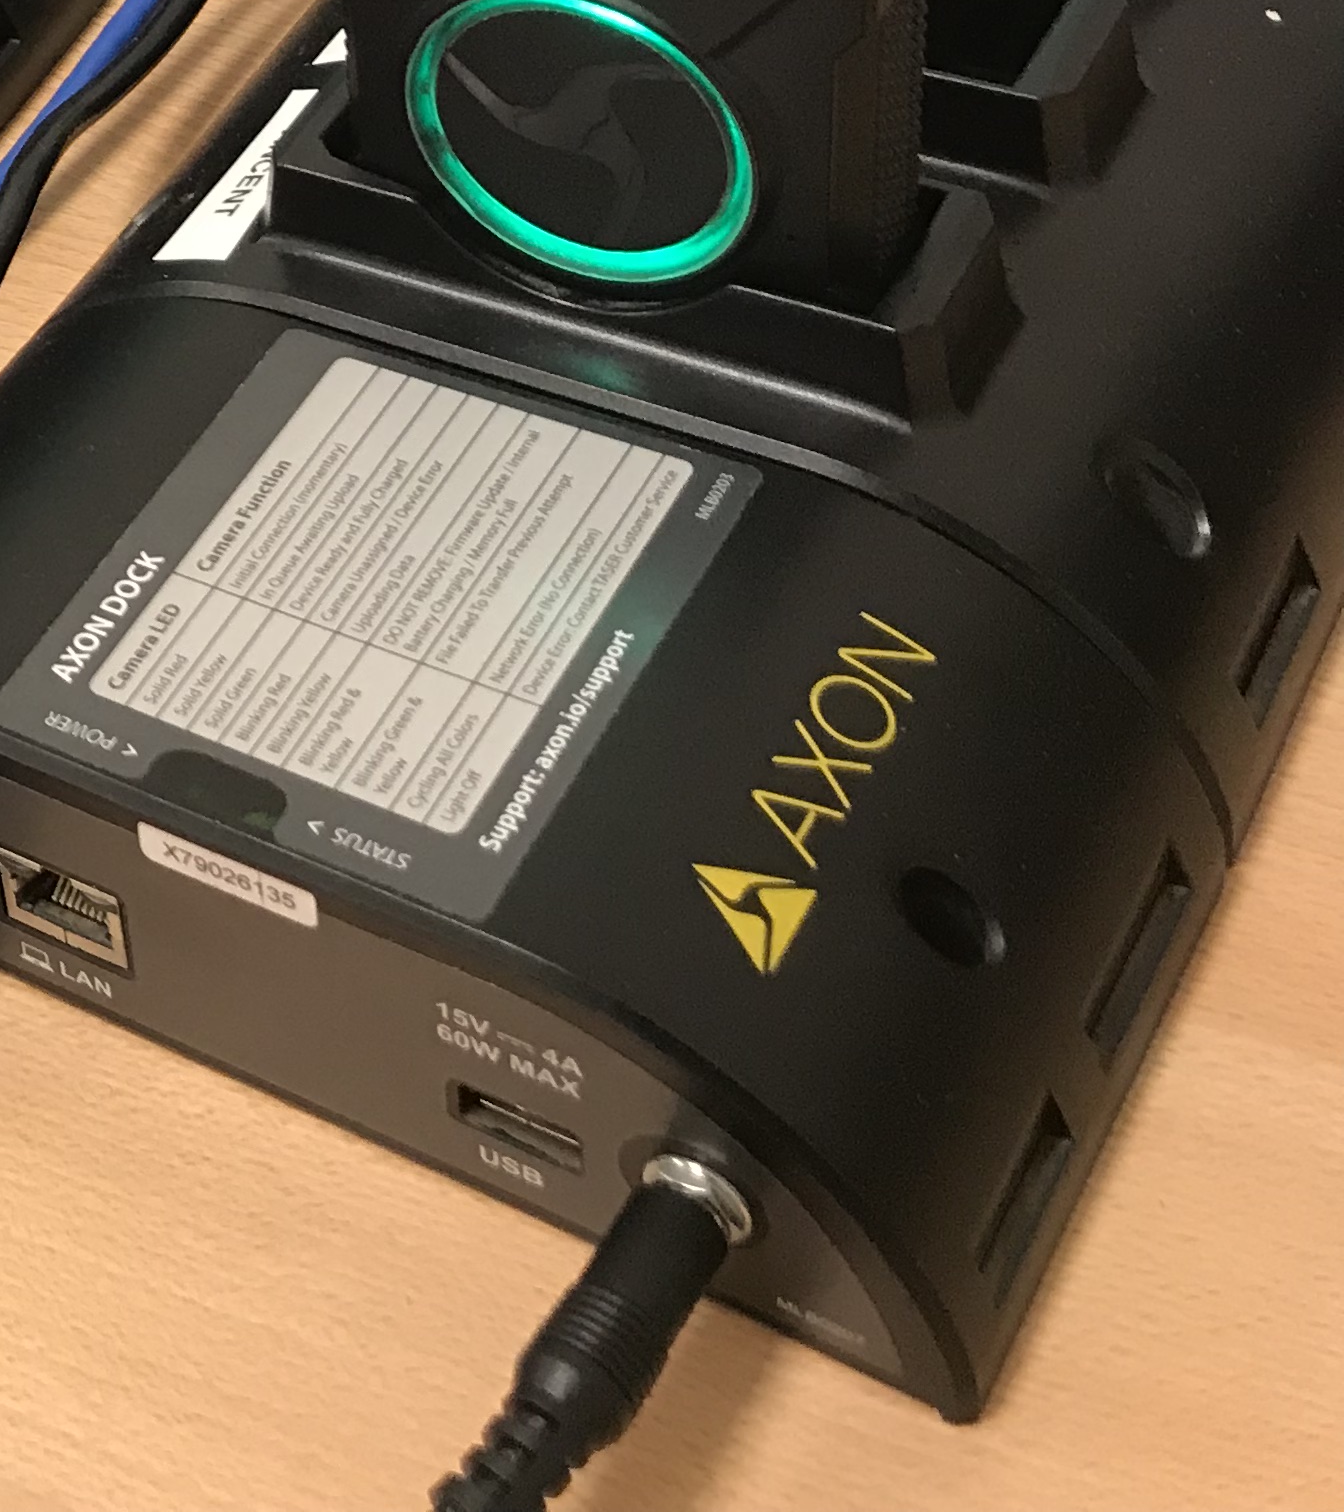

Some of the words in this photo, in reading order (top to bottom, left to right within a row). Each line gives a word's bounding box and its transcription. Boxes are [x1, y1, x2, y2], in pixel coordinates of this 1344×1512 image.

[196, 520, 246, 571] Camera
[235, 460, 291, 519] Function
[228, 558, 259, 589] Initial
[250, 503, 301, 560] Connection
[292, 442, 348, 504] (momentary)
[267, 554, 301, 588] Queue
[293, 510, 336, 554] Awaiting
[324, 473, 359, 509] Upload
[288, 575, 323, 611] Device
[314, 544, 348, 576] Ready
[340, 522, 361, 544] and
[351, 499, 380, 524] Fully
[369, 457, 408, 499] Charged
[319, 582, 357, 622] Camera
[348, 522, 398, 582] Unassigned
[393, 484, 426, 518] Device
[417, 459, 443, 485] Error
[394, 601, 419, 626] NOT
[443, 509, 486, 556] Firmware
[476, 473, 510, 509] Update
[505, 429, 540, 467] Internal
[350, 579, 401, 633] Uploading
[388, 554, 416, 579] Data
[402, 613, 440, 652] Battery
[429, 566, 474, 613] Charging
[466, 516, 507, 560] Memory
[495, 498, 518, 518] Full
[434, 643, 458, 664] File
[448, 611, 479, 644] Failed
[477, 556, 515, 597] Transfer
[506, 515, 546, 558] Previous
[536, 473, 573, 516] Attempt
[488, 637, 528, 683] Network
[518, 610, 545, 637] Error
[537, 590, 560, 610] (No
[551, 527, 602, 590] Connection)
[521, 657, 556, 696] Device
[566, 585, 603, 628] Contact
[591, 553, 623, 585] TASER
[613, 504, 653, 554] Customer
[645, 469, 678, 506] Service
[51, 614, 114, 683] AXON
[99, 550, 164, 616] DOCK
[107, 634, 159, 690] Camera
[148, 603, 180, 633] LED
[142, 675, 172, 704] Solid
[162, 653, 188, 677] Red
[173, 687, 202, 716] Solid
[194, 653, 227, 687] Yellow
[203, 699, 233, 728] Solid
[224, 667, 256, 701] Green
[234, 696, 278, 741] Blinking
[266, 673, 291, 696] Red
[266, 708, 310, 754] Blinking
[296, 672, 331, 707] Yellow
[44, 711, 117, 750] POWER
[297, 720, 342, 767] Blinking
[329, 696, 355, 720] Red
[318, 736, 353, 773] Yellow
[351, 740, 395, 788] Blinking
[383, 706, 415, 740] Green
[406, 766, 447, 808] Cycling
[435, 748, 454, 766] All
[445, 713, 479, 749] Colors
[478, 769, 545, 852] Support:
[535, 629, 634, 770] axon.io/support
[751, 610, 937, 870] AXON
[372, 757, 407, 794] Yellow
[439, 790, 469, 822] Light
[460, 768, 481, 790] Off
[161, 840, 297, 911] X79026135
[330, 827, 411, 869] STATUS
[59, 960, 113, 999] LAN
[435, 1001, 491, 1037] 15V
[541, 1048, 585, 1080] 4A
[436, 1022, 502, 1064] 60W
[509, 1053, 582, 1100] MAX
[477, 1143, 546, 1189] USB
